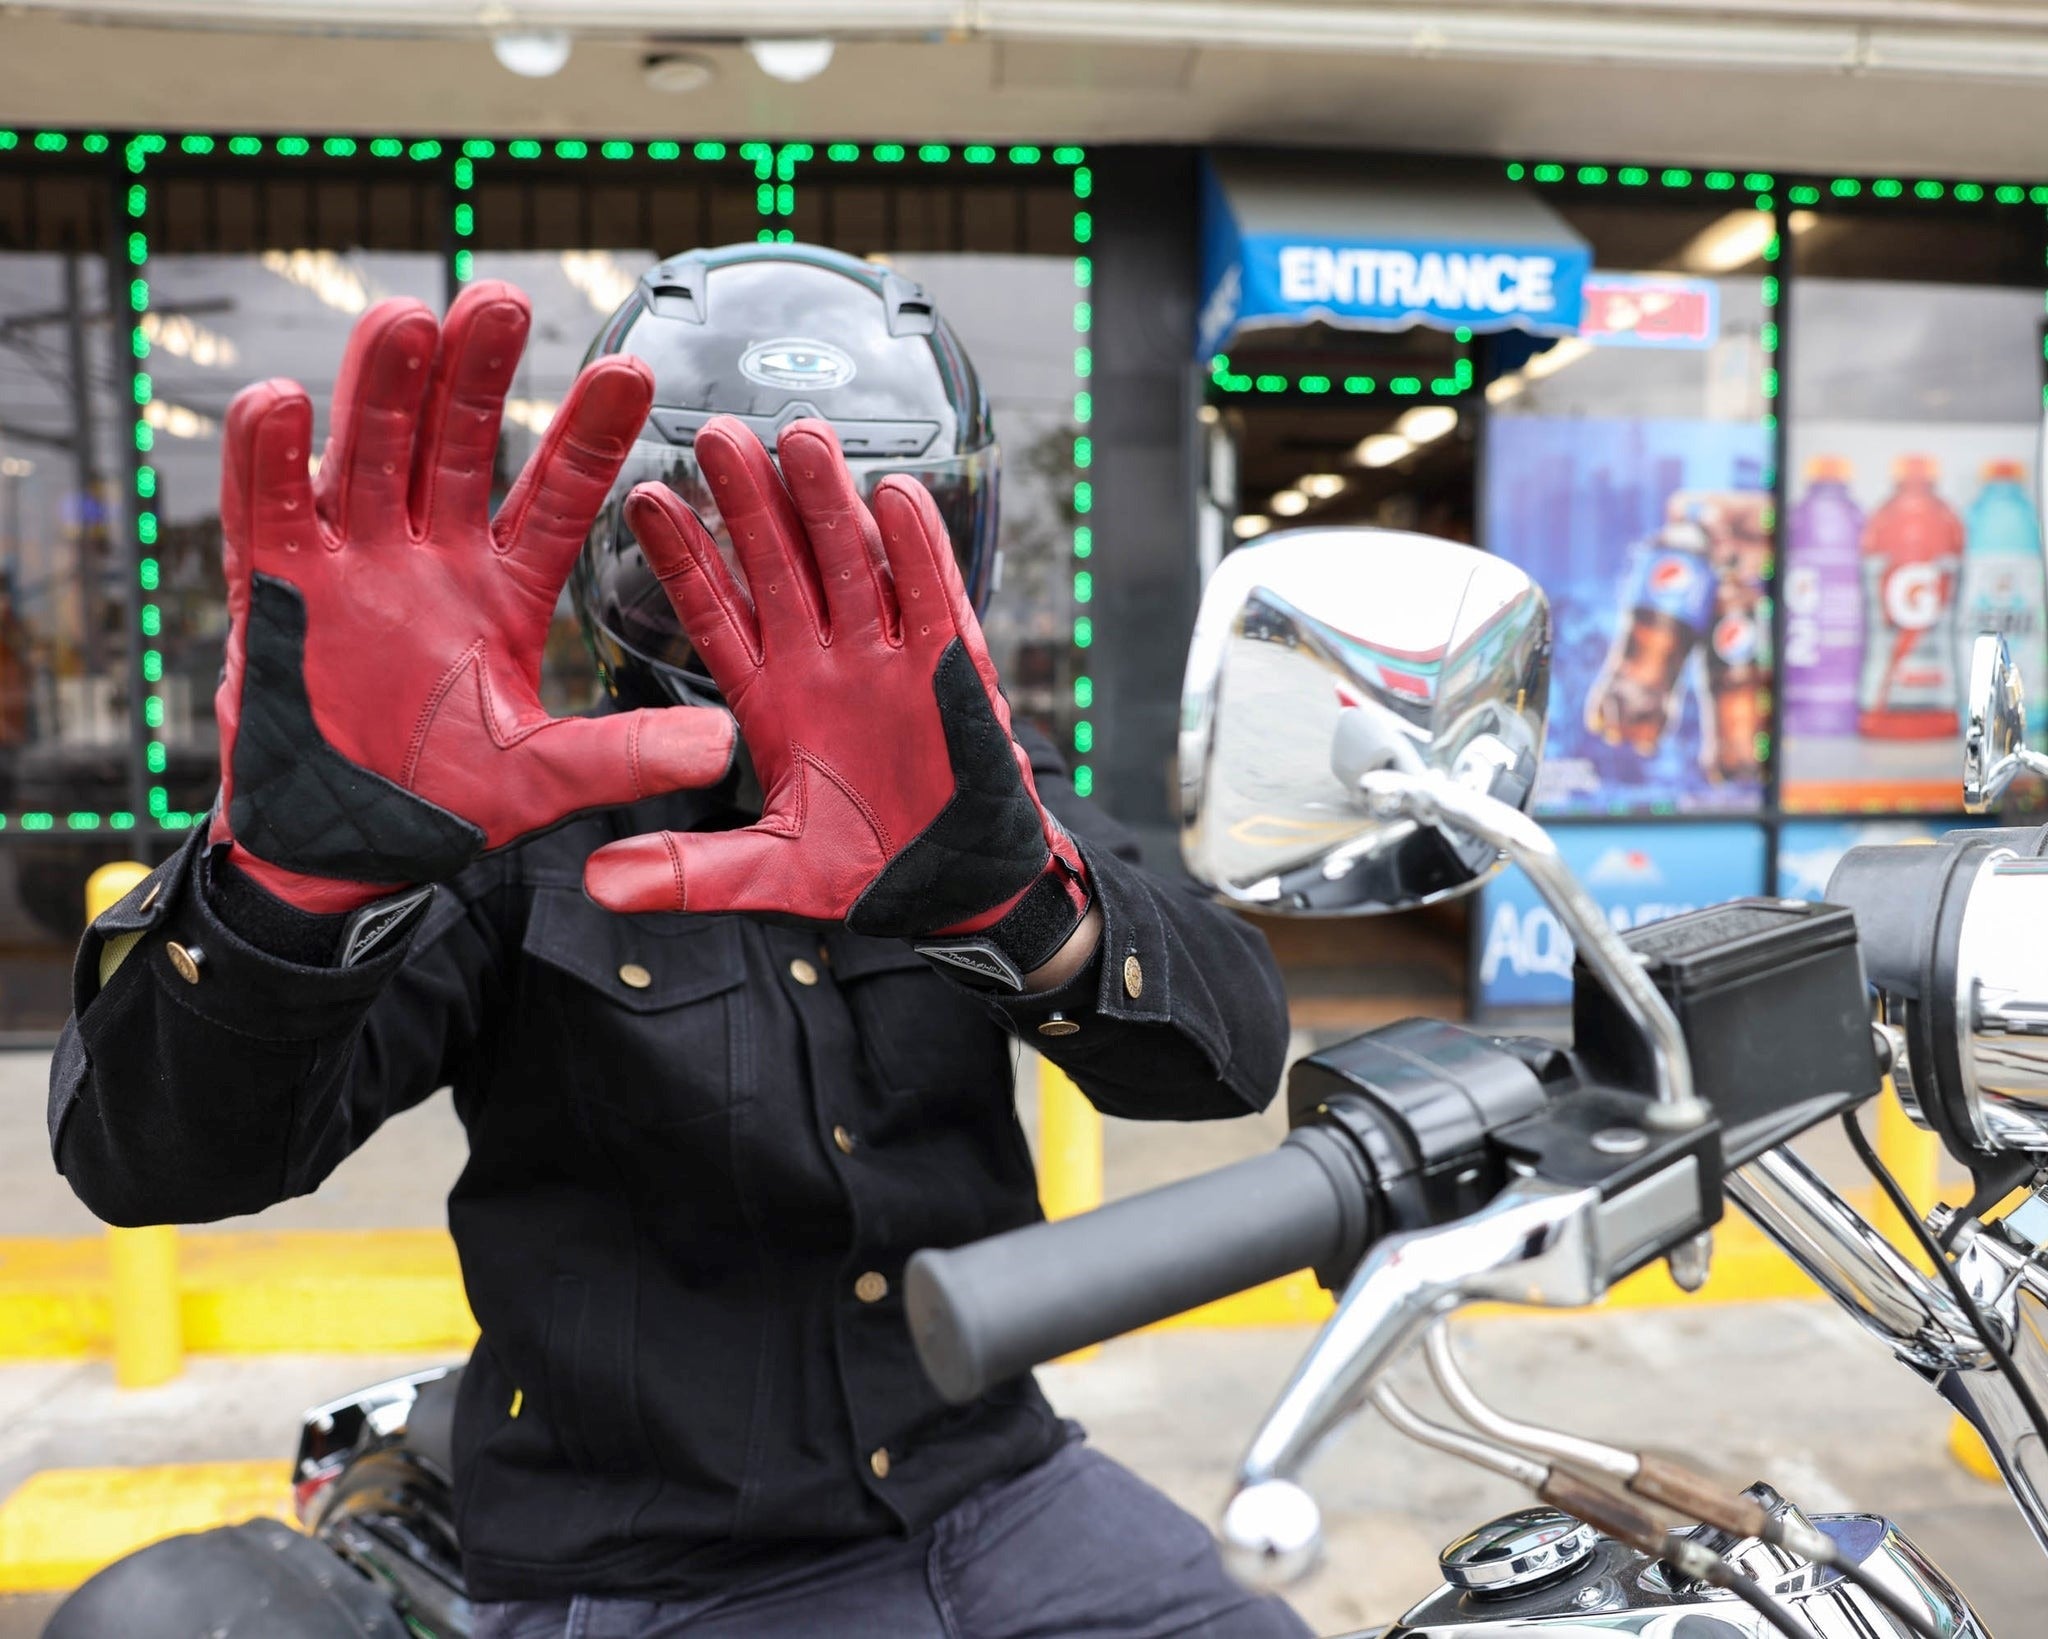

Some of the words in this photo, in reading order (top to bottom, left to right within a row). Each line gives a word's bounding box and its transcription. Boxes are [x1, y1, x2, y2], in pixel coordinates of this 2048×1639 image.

[1279, 245, 1556, 312] ENTRANCE
[1885, 562, 1942, 629] G
[948, 951, 1002, 974] THRASHIN
